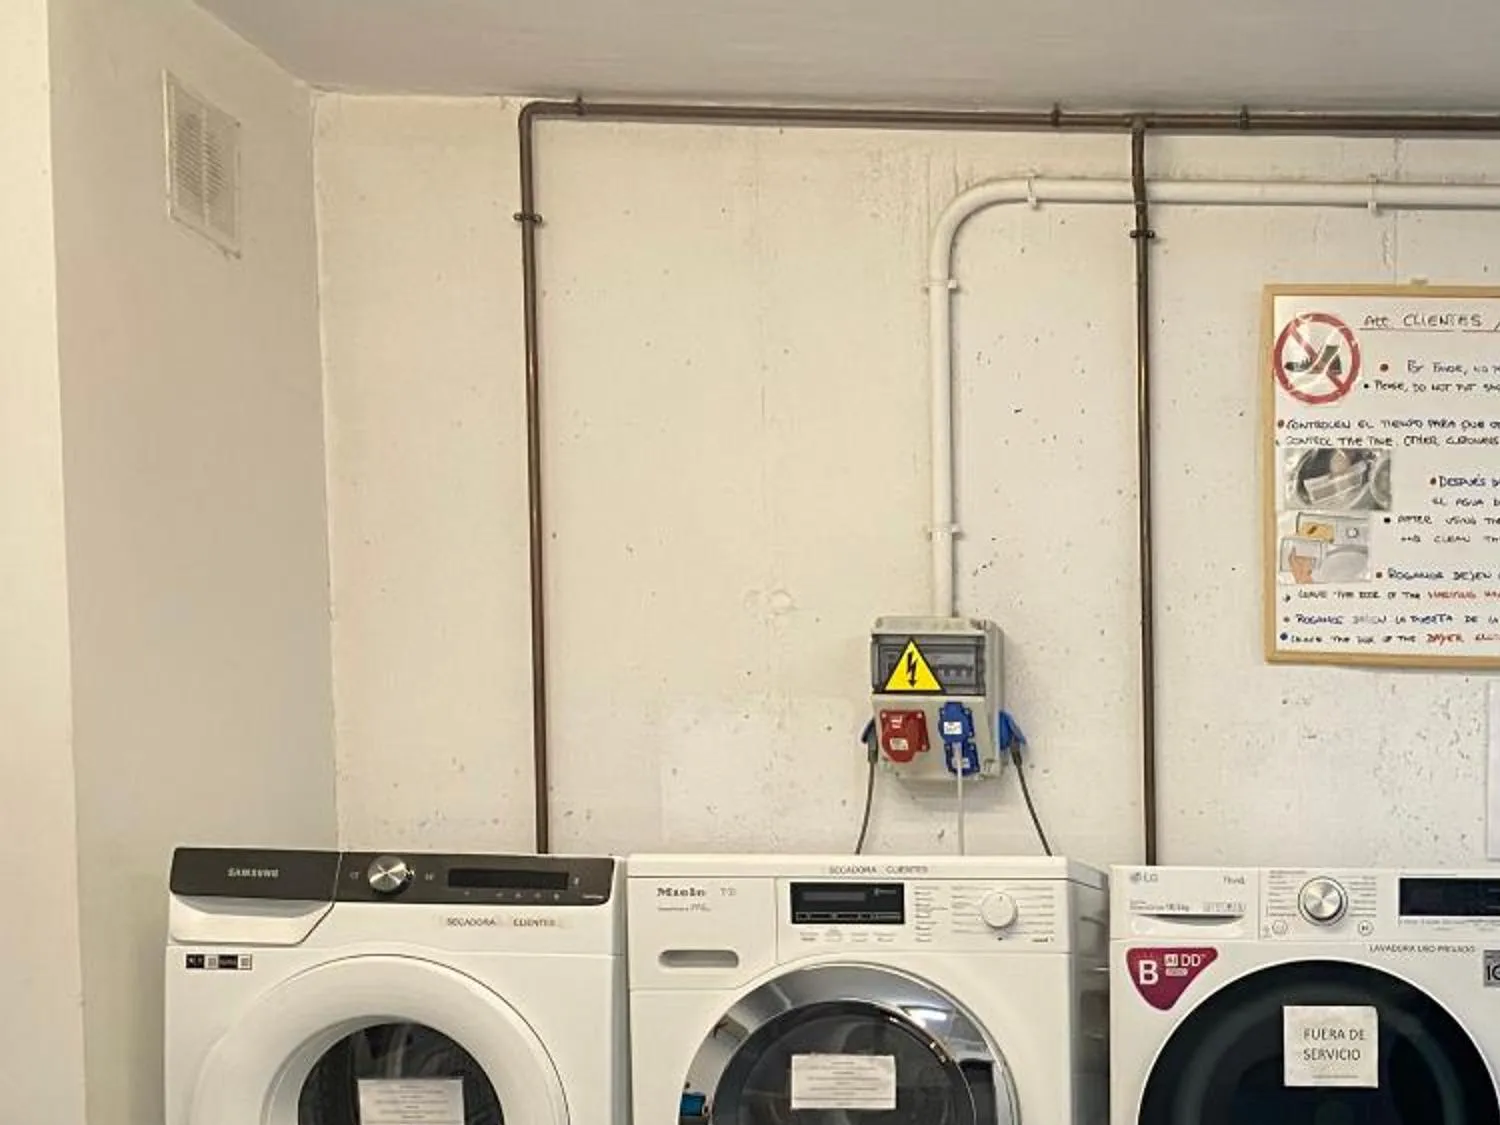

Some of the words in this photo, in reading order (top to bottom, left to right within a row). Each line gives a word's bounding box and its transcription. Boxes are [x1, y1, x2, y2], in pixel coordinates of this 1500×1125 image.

[1403, 313, 1482, 327] CLIENTES
[1413, 383, 1427, 392] DO
[1432, 382, 1450, 392] NOT
[1456, 383, 1477, 391] PUT
[1358, 421, 1375, 429] EL
[1428, 419, 1456, 429] PARA
[1461, 420, 1485, 431] QUE
[1338, 437, 1362, 446] THE
[1455, 498, 1484, 506] AGUA
[1434, 534, 1471, 544] CLEAN
[1464, 615, 1478, 623] DE
[227, 867, 280, 878] SAMSUNG
[829, 866, 878, 874] SECADORA
[886, 865, 929, 874] CLIENTES
[657, 887, 706, 897] Miele
[447, 917, 497, 927] SECADORA
[513, 917, 556, 927] CLIENTES
[1138, 959, 1160, 986] B
[1303, 1027, 1345, 1041] FUERA
[1349, 1028, 1367, 1041] DE
[1303, 1047, 1361, 1061] SERVICIO
